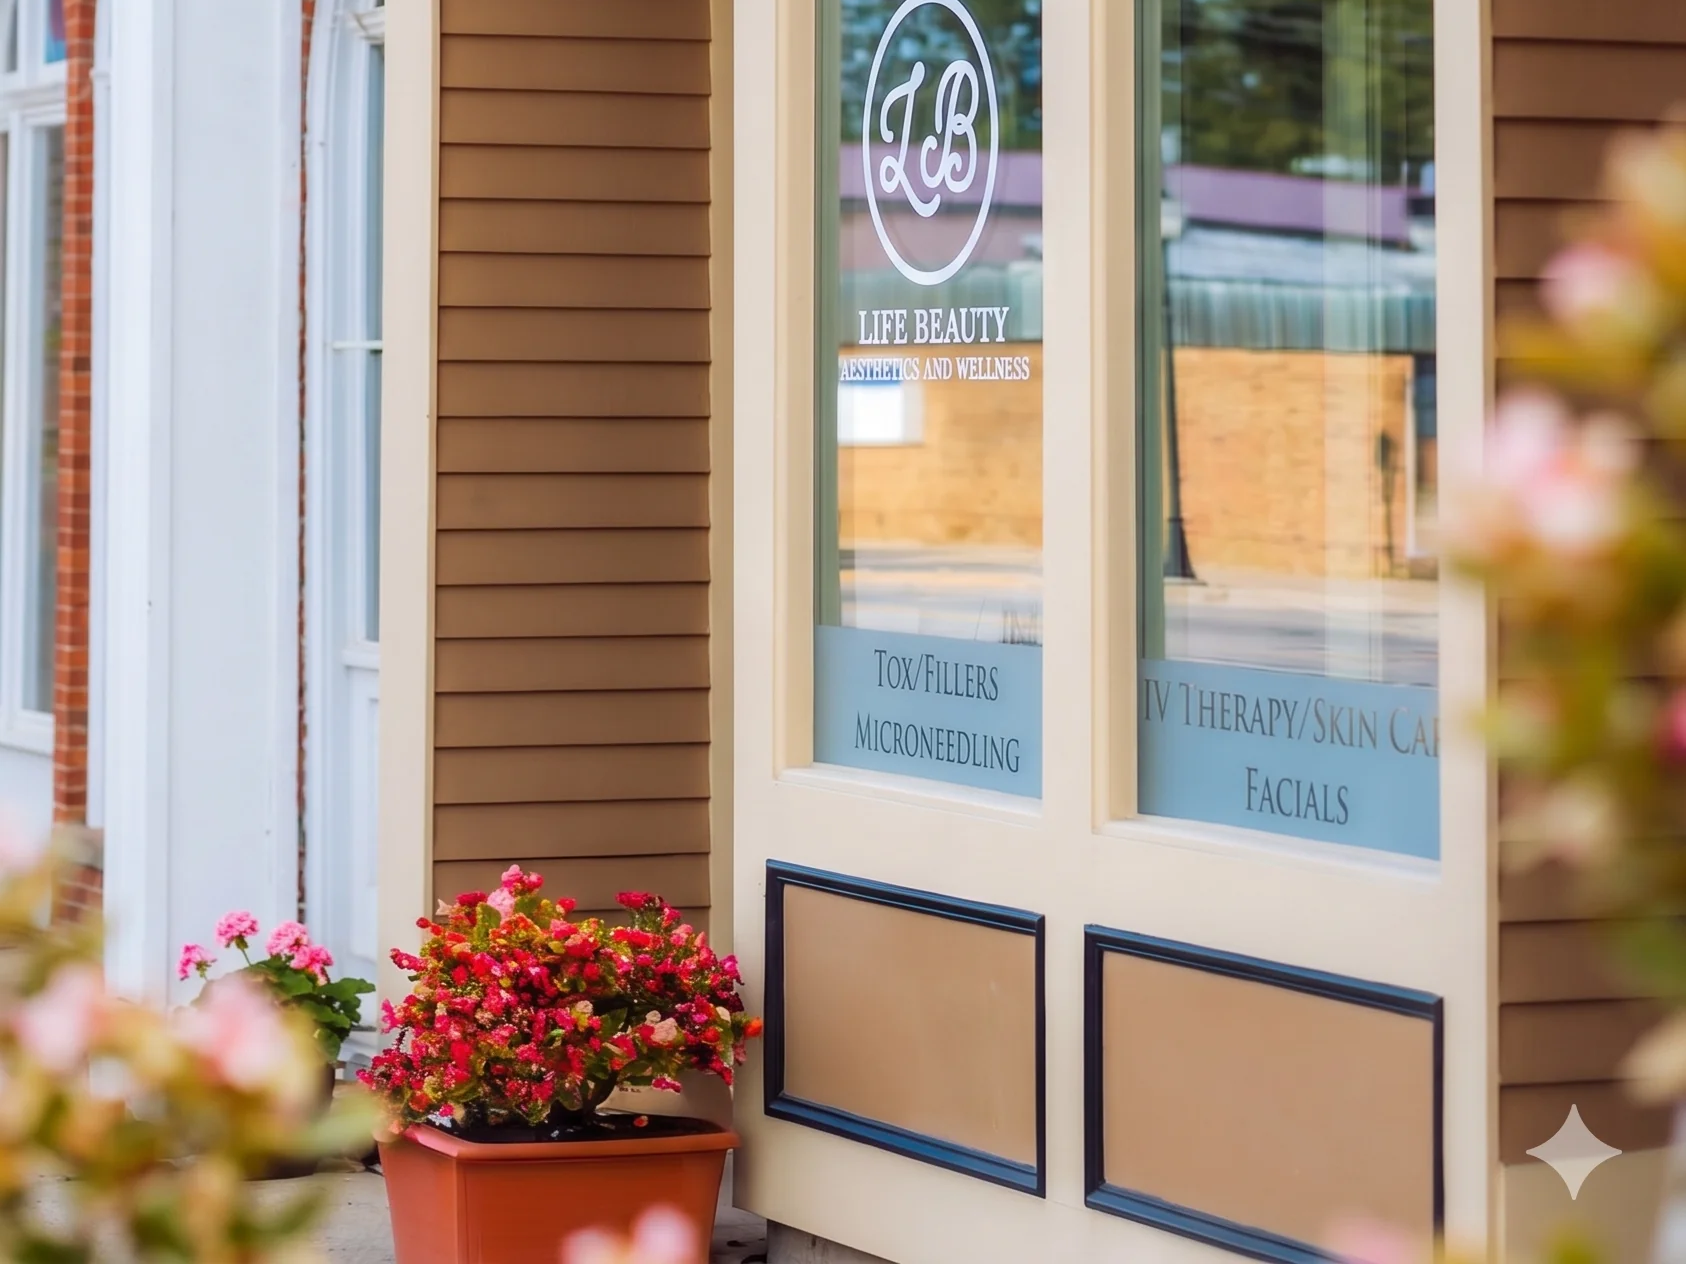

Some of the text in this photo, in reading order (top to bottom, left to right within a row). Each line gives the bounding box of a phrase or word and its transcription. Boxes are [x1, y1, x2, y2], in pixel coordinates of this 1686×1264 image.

[858, 306, 1010, 345] LIFE BEAUTY
[840, 355, 1030, 381] AESTHETICS AND WELLNESS
[1143, 677, 1172, 723] IV
[854, 710, 1021, 773] MICRONEEDLING
[1245, 766, 1350, 826] FACIALS
